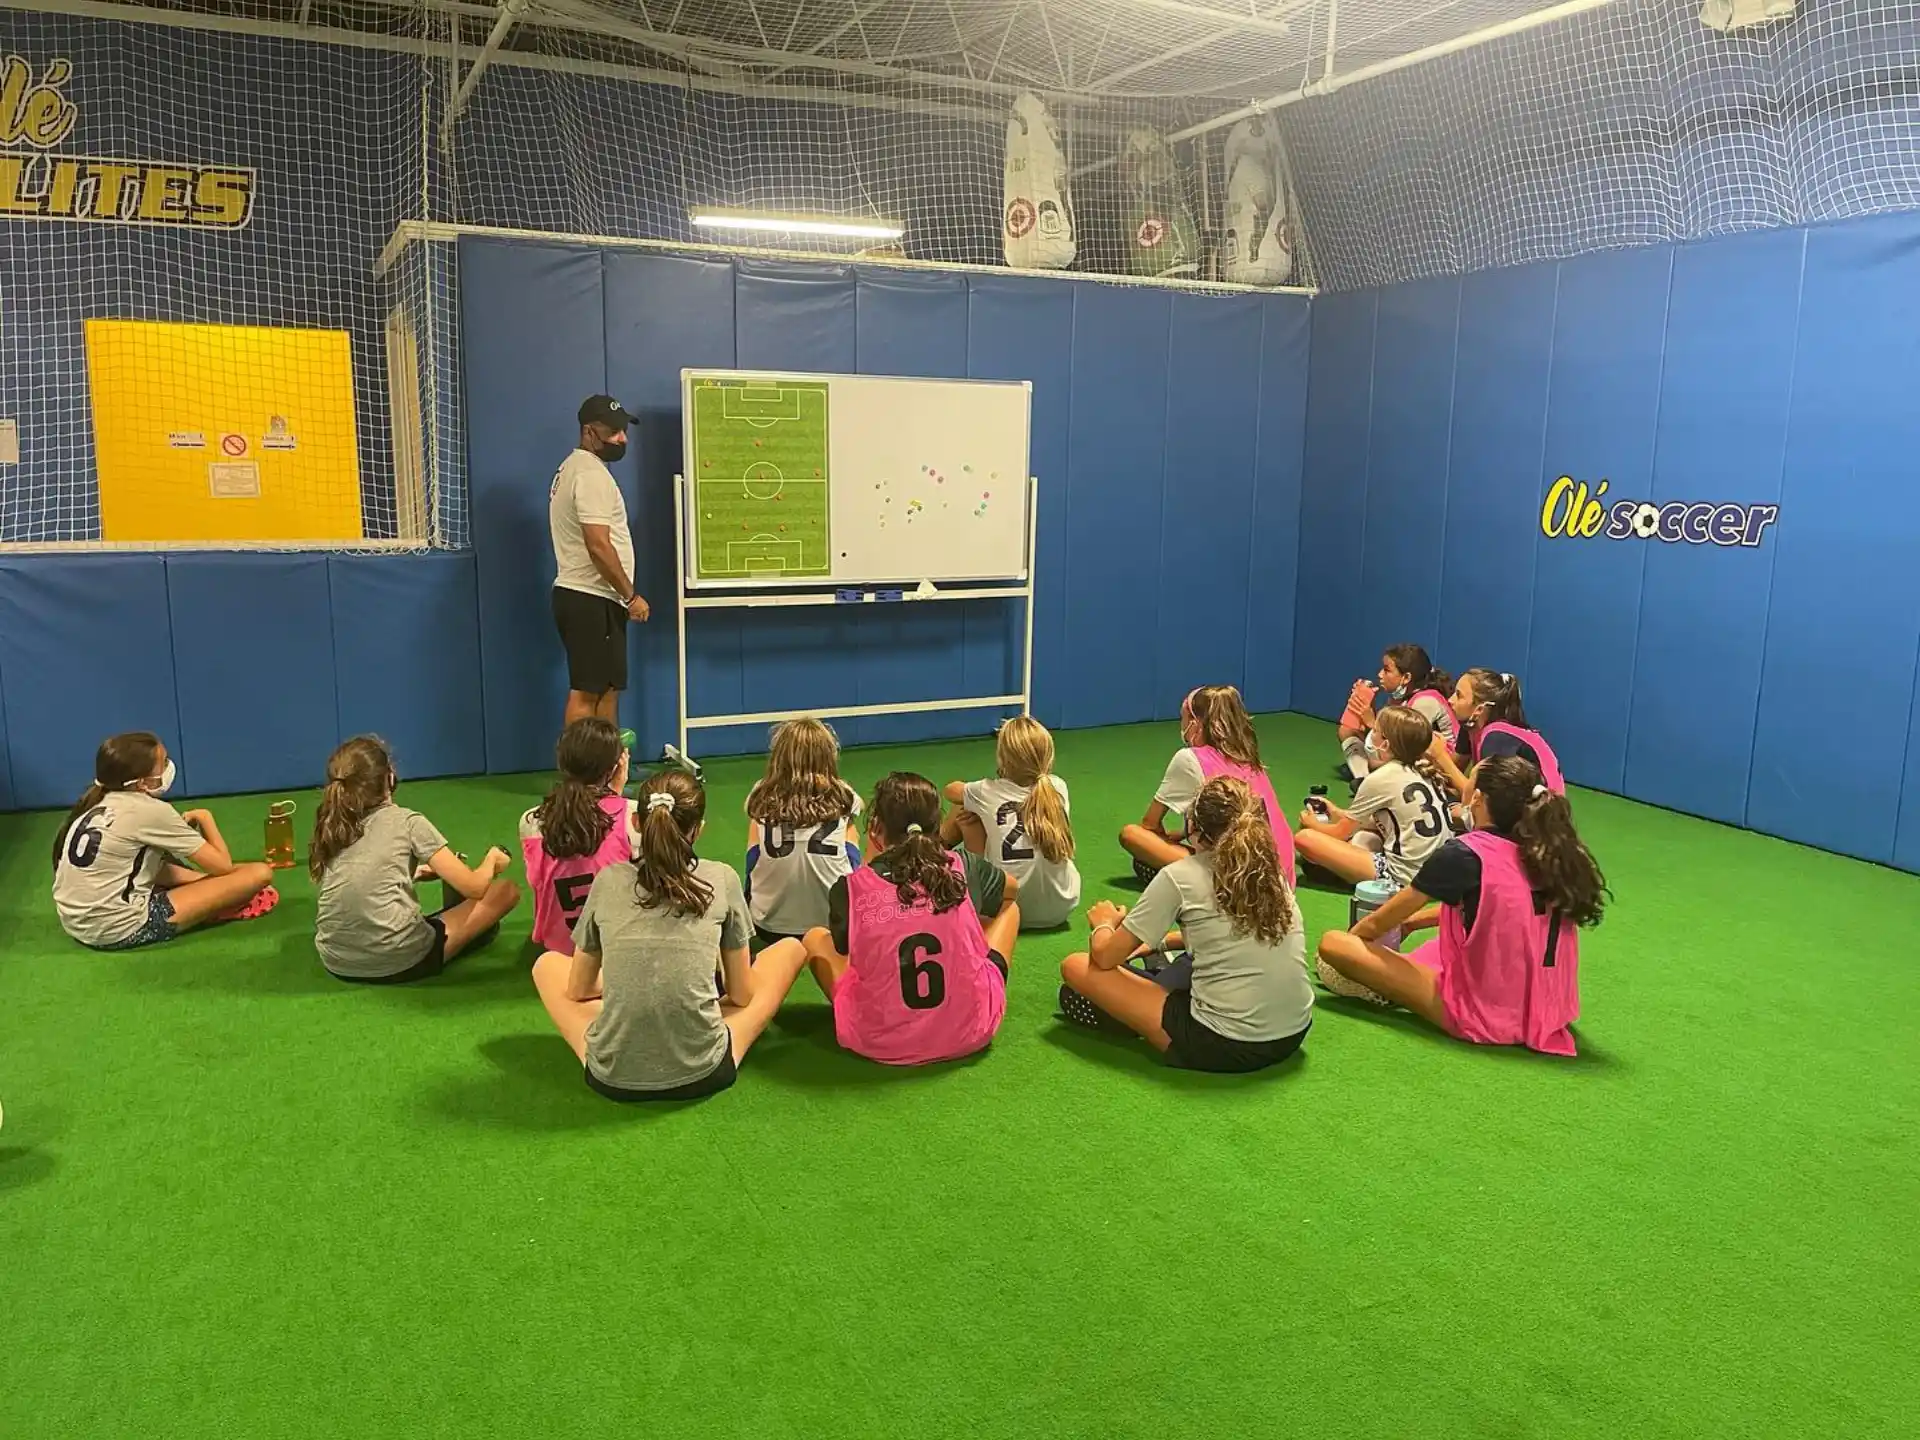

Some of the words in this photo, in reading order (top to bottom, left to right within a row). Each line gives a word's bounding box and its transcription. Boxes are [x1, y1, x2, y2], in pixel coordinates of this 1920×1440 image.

[0, 57, 76, 148] lé
[1541, 474, 1609, 538] Olé
[68, 806, 106, 868] 6
[898, 932, 945, 1010] 6
